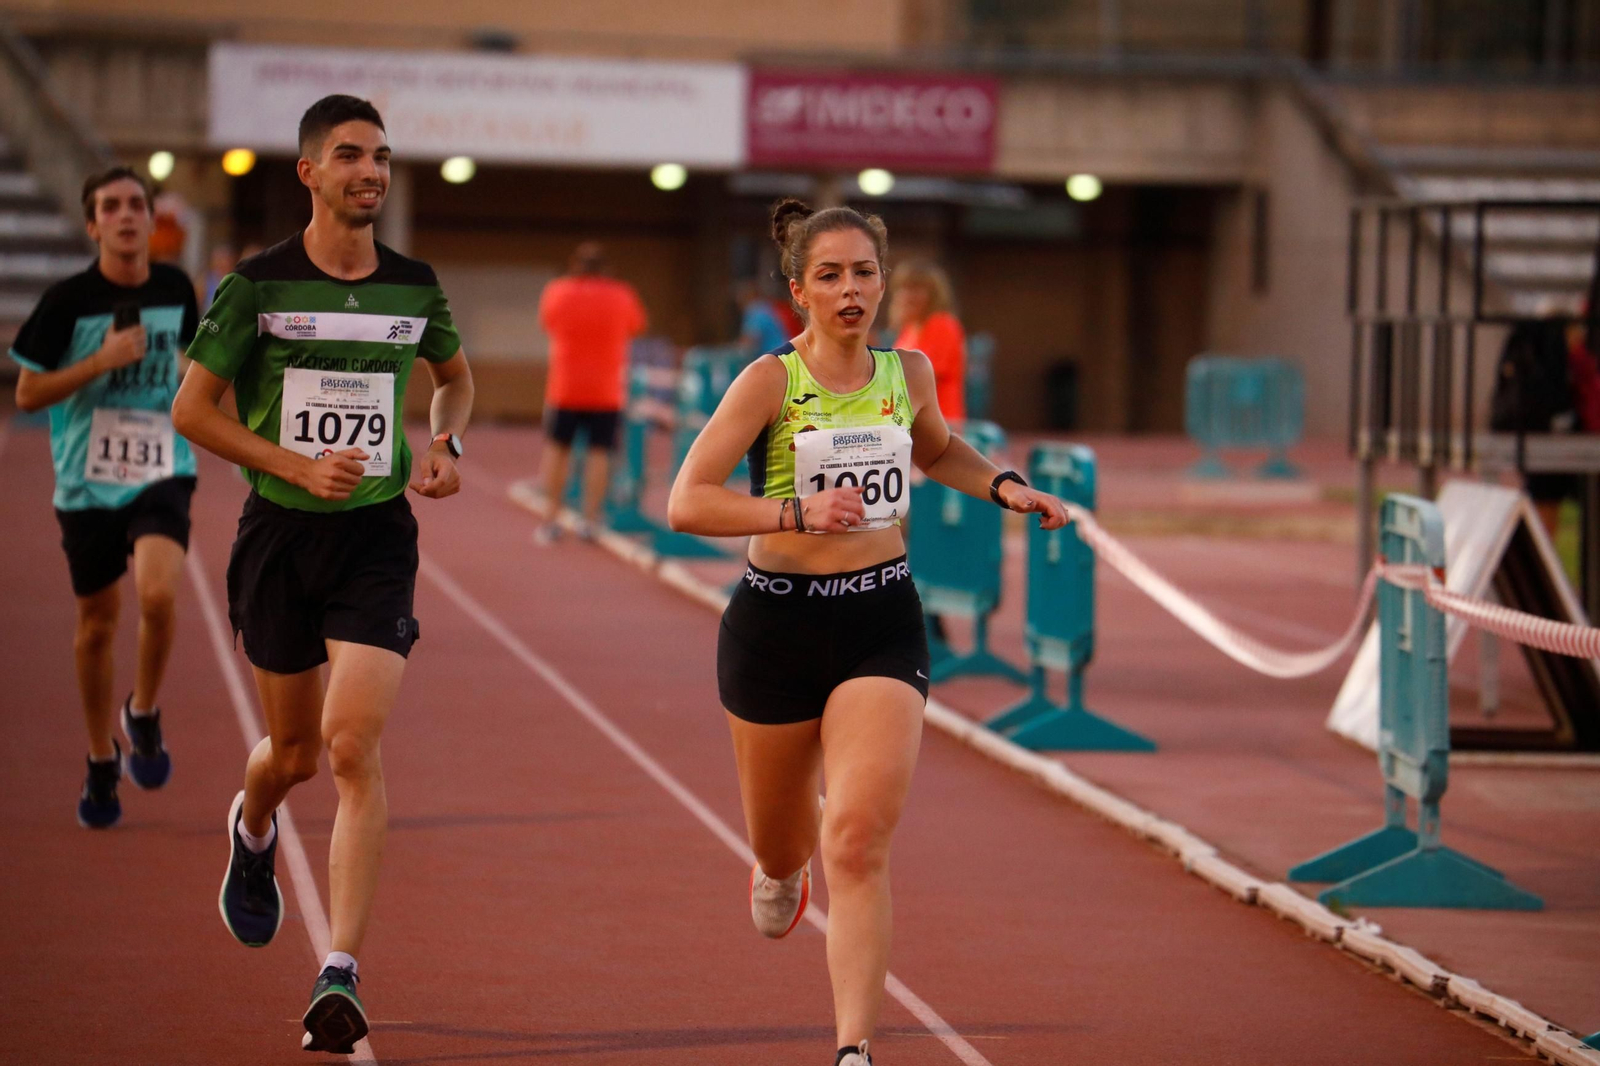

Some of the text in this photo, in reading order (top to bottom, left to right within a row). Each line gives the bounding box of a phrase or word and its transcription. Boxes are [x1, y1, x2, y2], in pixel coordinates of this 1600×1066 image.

[802, 84, 994, 133] IMDECO
[294, 410, 386, 446] 1079
[833, 433, 874, 441] carreras
[833, 436, 882, 446] populares
[98, 436, 164, 467] 1131
[807, 571, 876, 596] NIKE
[882, 561, 910, 586] PR
